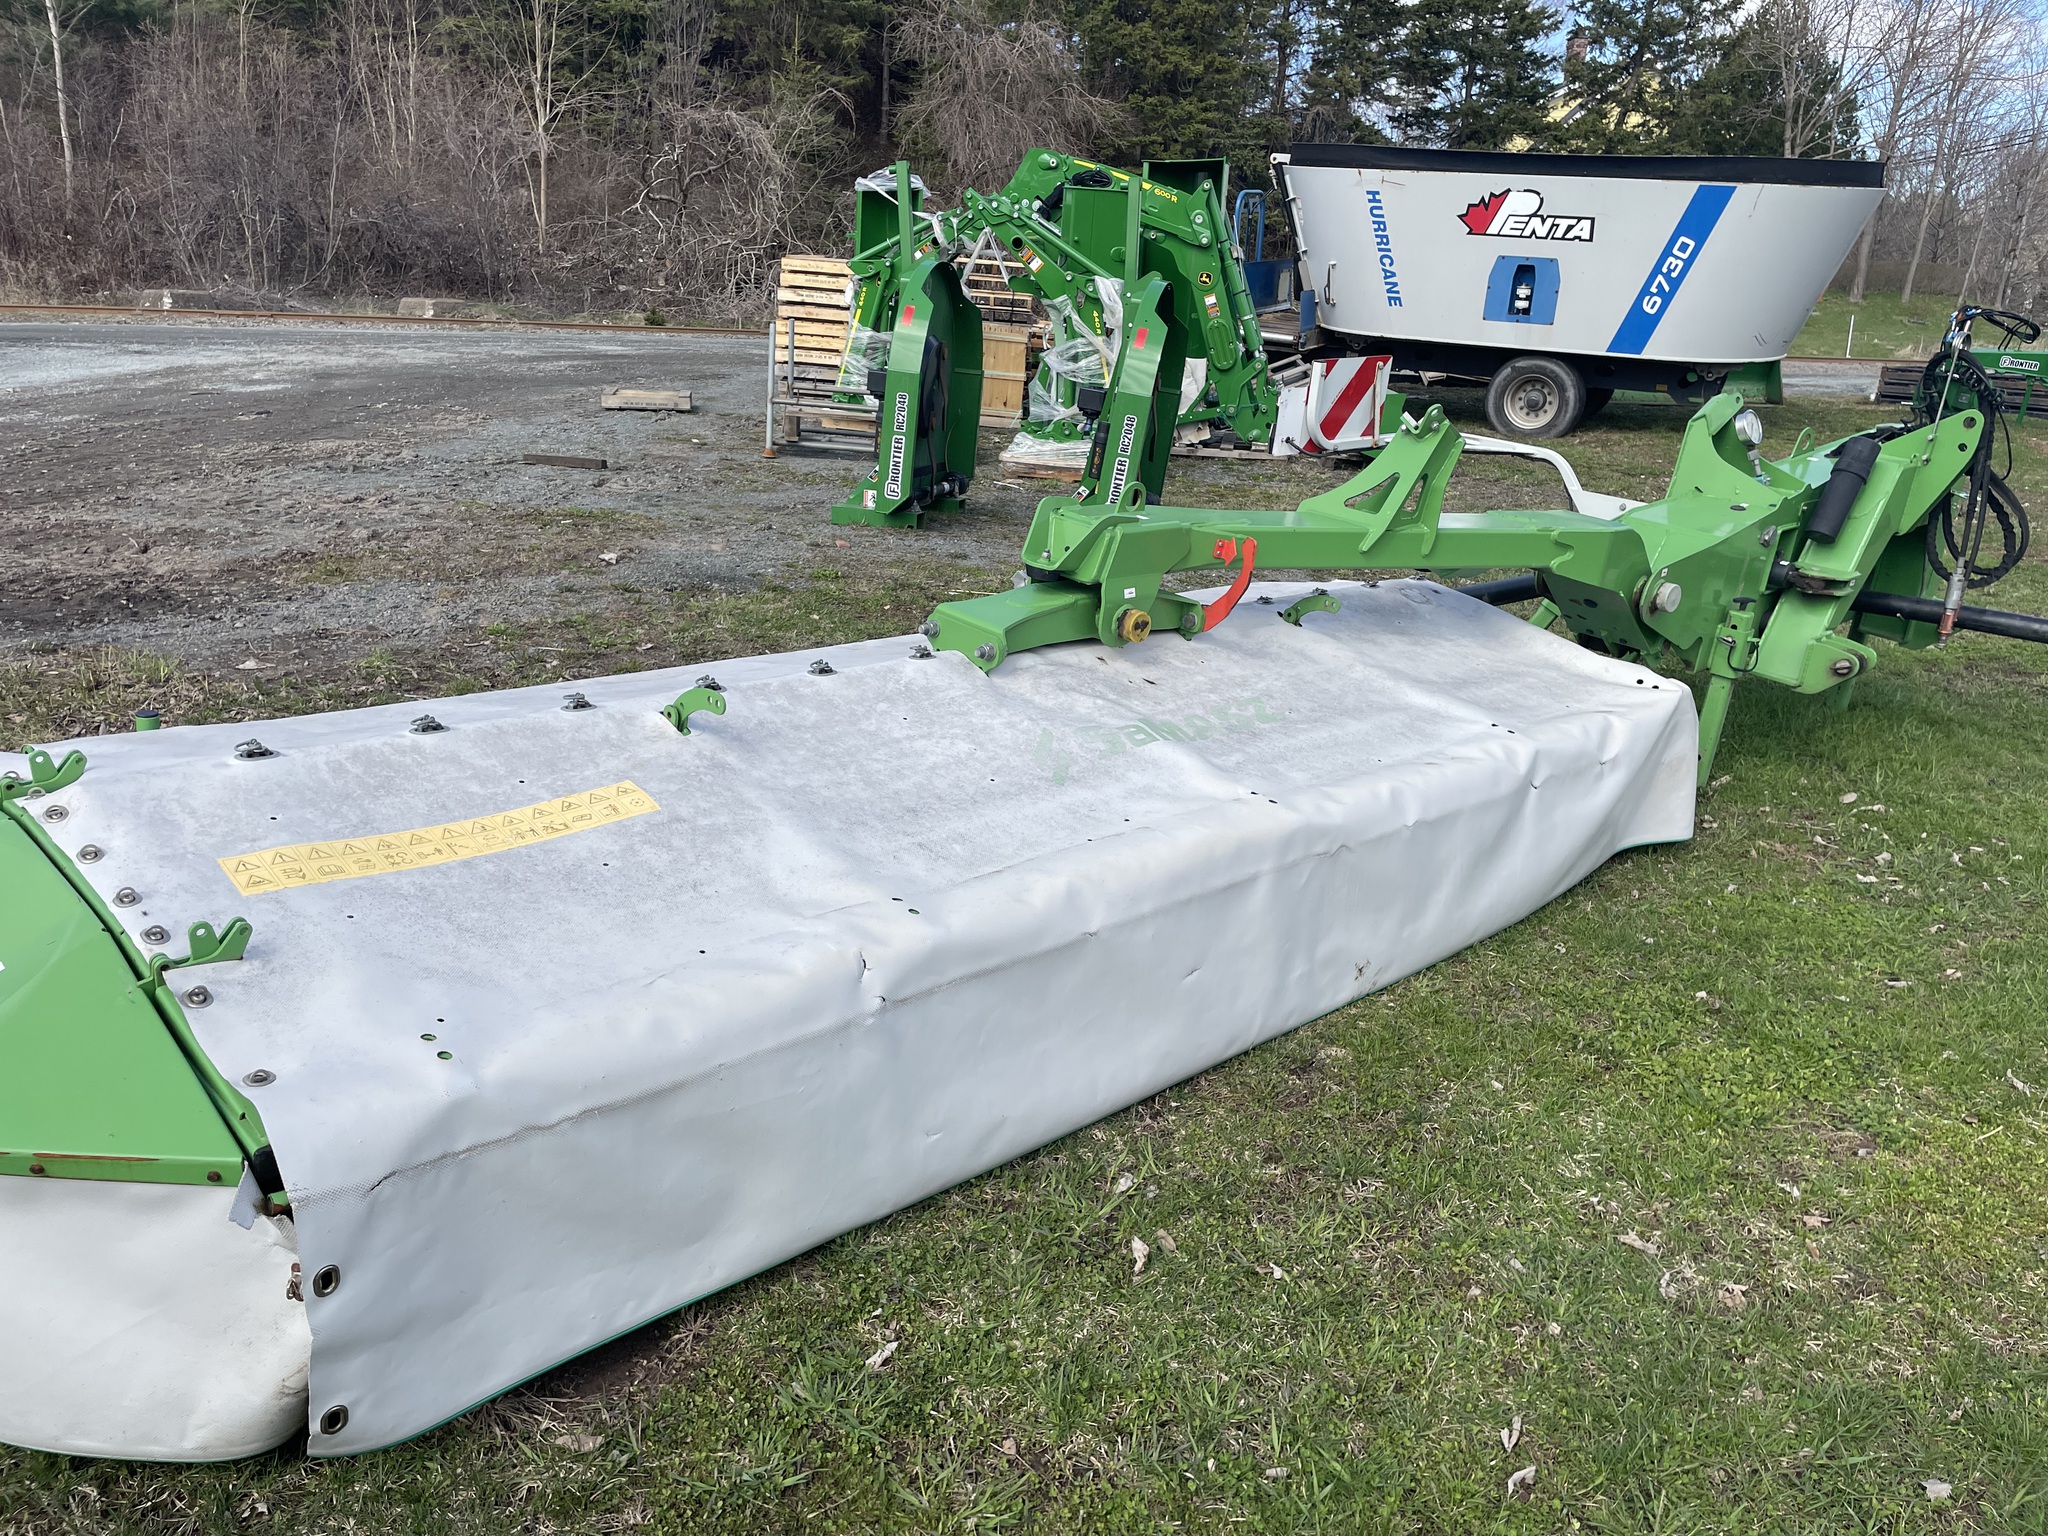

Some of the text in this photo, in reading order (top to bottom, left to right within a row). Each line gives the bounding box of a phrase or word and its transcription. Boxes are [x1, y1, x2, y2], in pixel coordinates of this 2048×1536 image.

[1366, 190, 1403, 307] HURRICANE
[1486, 188, 1595, 242] PENTA
[1642, 236, 1696, 315] 6730
[2000, 356, 2039, 370] FRONTIER
[885, 393, 908, 498] FRONTIER RC2048
[1109, 415, 1137, 505] RONTIER RC2048
